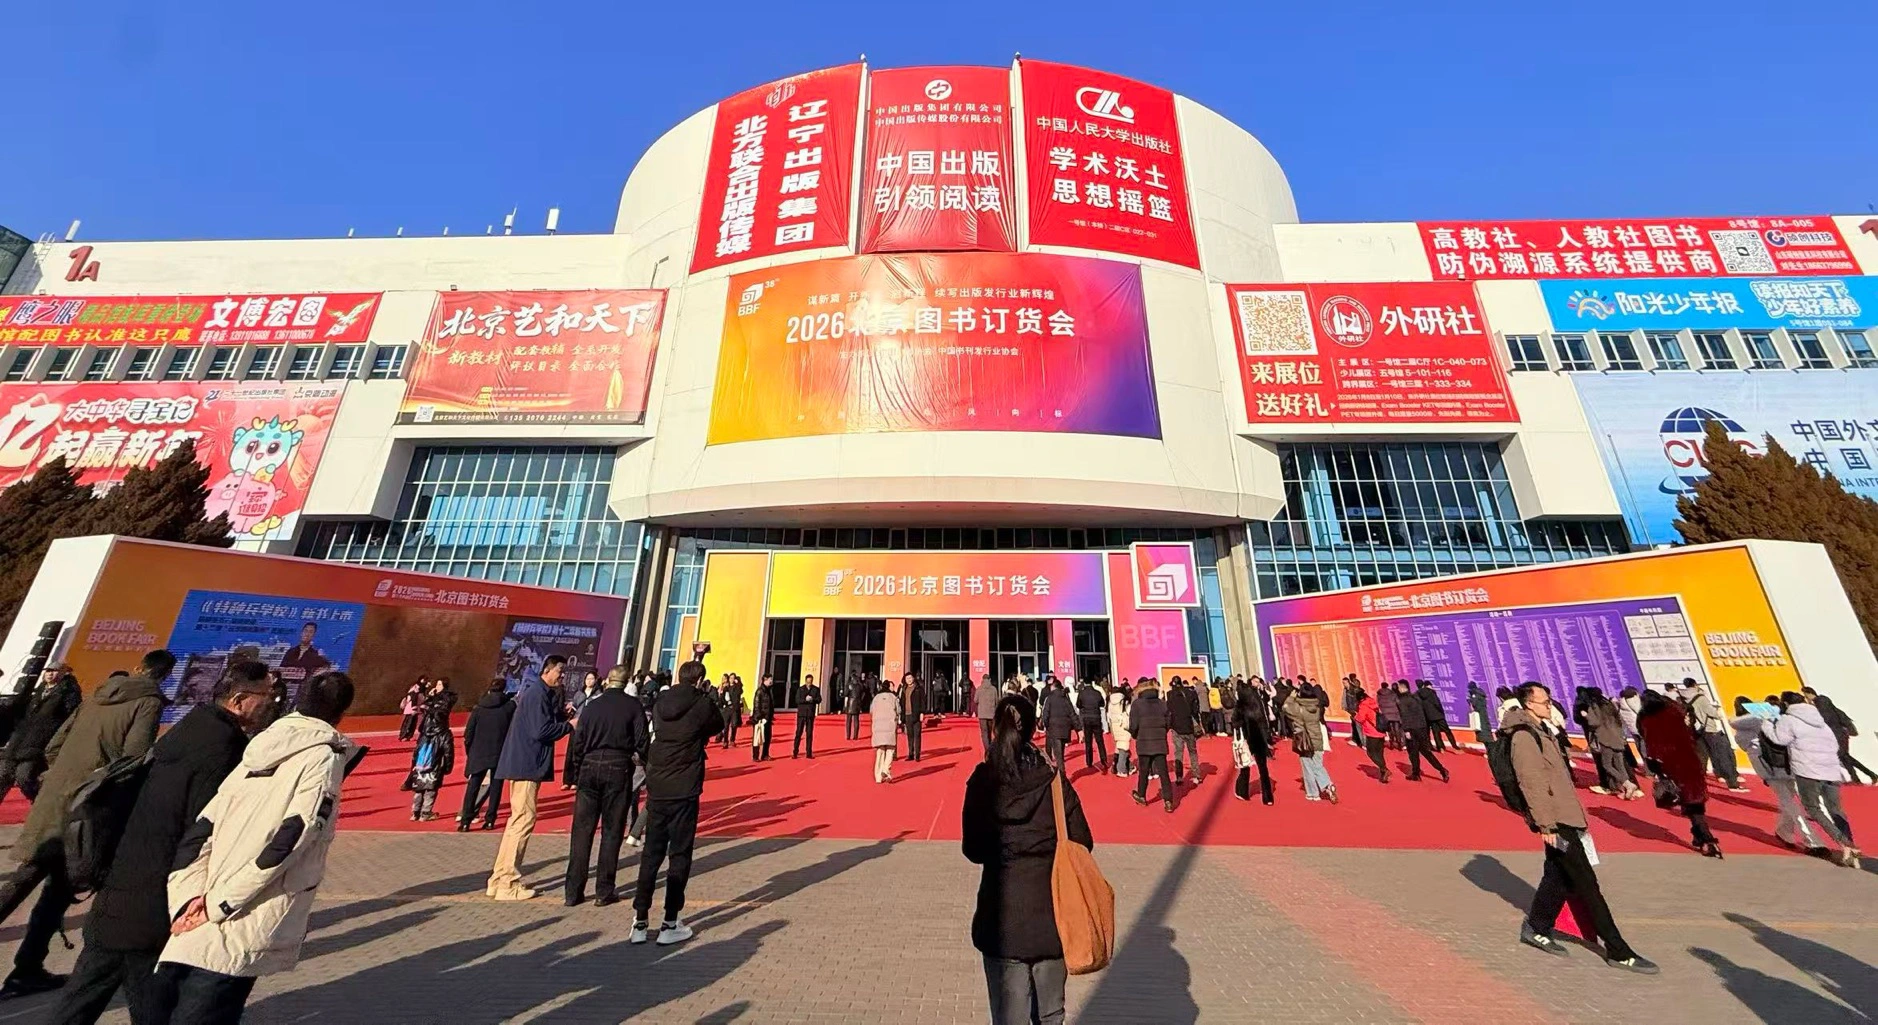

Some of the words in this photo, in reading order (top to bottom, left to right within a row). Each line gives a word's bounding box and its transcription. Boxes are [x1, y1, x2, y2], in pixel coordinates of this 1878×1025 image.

[874, 113, 1002, 127] 中国出版传媒股份有限公司
[875, 103, 1002, 116] 中国出版集团有限公司
[1036, 115, 1174, 155] 中国人民大学出版社
[774, 99, 828, 246] 辽宁出版集团
[876, 150, 1001, 177] 中国出版
[1049, 146, 1169, 190] 学术沃土
[715, 114, 769, 258] 北方联合出版传媒
[874, 184, 1001, 214] 引领阅读
[1051, 178, 1174, 222] 思想摇篮
[1428, 223, 1706, 251] 高教社、人教社图书
[64, 245, 101, 283] 1A
[1436, 249, 1719, 276] 防伪溯源系统提供商
[807, 293, 841, 306] 谋新篇
[934, 287, 1055, 300] 续写出版发行业新辉煌
[1752, 282, 1848, 299] 读报知天下
[5, 299, 86, 326] 鹰之眼
[204, 296, 328, 329] 文博宏图
[737, 303, 762, 317] BBF
[1614, 291, 1745, 316] 阳光少年报
[1766, 298, 1860, 317] 少年好素养
[437, 300, 655, 341] 北京艺和天下
[1379, 305, 1482, 336] 外研社
[0, 327, 193, 342] 馆配图书认准这只鹰
[447, 350, 501, 366] 新教材
[938, 346, 1019, 356] 中国书刊发行业协会
[568, 360, 622, 373] 全面合作
[1250, 360, 1324, 386] 来展位
[1379, 368, 1405, 378] 五号馆
[63, 395, 200, 425] 大中华寻宝记
[1255, 392, 1329, 418] 送好礼
[1804, 448, 1878, 470] 中国
[822, 587, 843, 596] BBF
[852, 574, 1051, 597] 2026北京图书订货会
[435, 589, 510, 609] 北京图书订货会
[1410, 587, 1490, 609] 北京图书订货会
[91, 619, 146, 631] BEIJING
[87, 632, 128, 644] BOOK
[128, 634, 158, 645] FAIR
[1120, 624, 1178, 650] BBF
[1703, 631, 1758, 645] BEIJING
[1708, 645, 1752, 659] BOOK
[1750, 644, 1783, 658] FAIR
